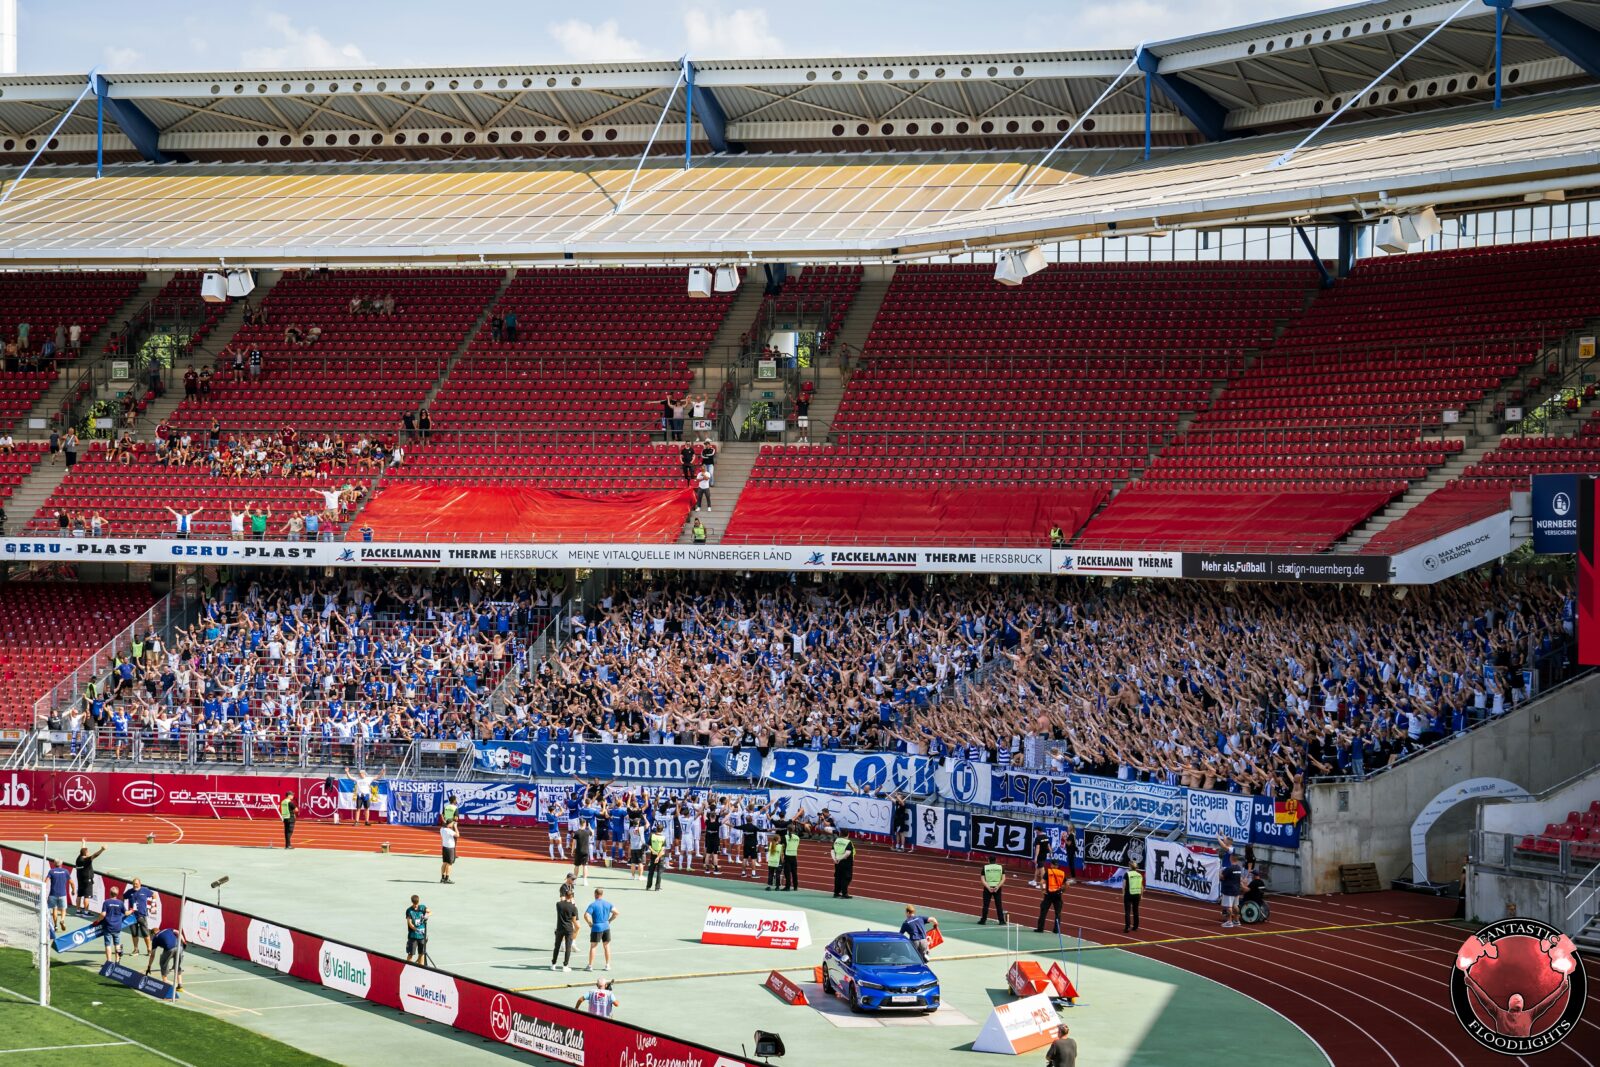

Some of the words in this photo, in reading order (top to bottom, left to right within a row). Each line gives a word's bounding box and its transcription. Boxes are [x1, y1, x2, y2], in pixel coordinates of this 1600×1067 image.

[1438, 549, 1454, 559] MAX
[1455, 534, 1491, 551] MORLOCK
[361, 548, 440, 559] FACKELMANN
[449, 549, 497, 560] THERME
[500, 550, 558, 560] HERSBRUCK
[568, 550, 600, 560] MEINE
[602, 550, 671, 561] VITALQUELLE
[673, 551, 685, 561] IM
[687, 549, 760, 562] NÜRNBERGER
[763, 551, 792, 562] LAND
[832, 552, 916, 563] FACKELMANN
[925, 553, 977, 564] THERME
[981, 554, 1043, 565] HERSBRUCK
[1440, 548, 1471, 565] STADION
[1077, 556, 1133, 567] FACKELMANN
[1138, 557, 1173, 569] THERME
[1201, 560, 1221, 572] Mehr
[544, 743, 592, 775] für
[389, 781, 443, 793] WEISSENFELS
[1000, 772, 1067, 810] 1965
[67, 790, 92, 802] FCN
[311, 796, 337, 809] FCN
[1263, 822, 1283, 836] OST
[258, 944, 281, 962] ULHAAS
[332, 957, 367, 987] Vaillant
[492, 1011, 510, 1031] FCN
[512, 1012, 564, 1044] Handwerker
[565, 1028, 584, 1050] Club
